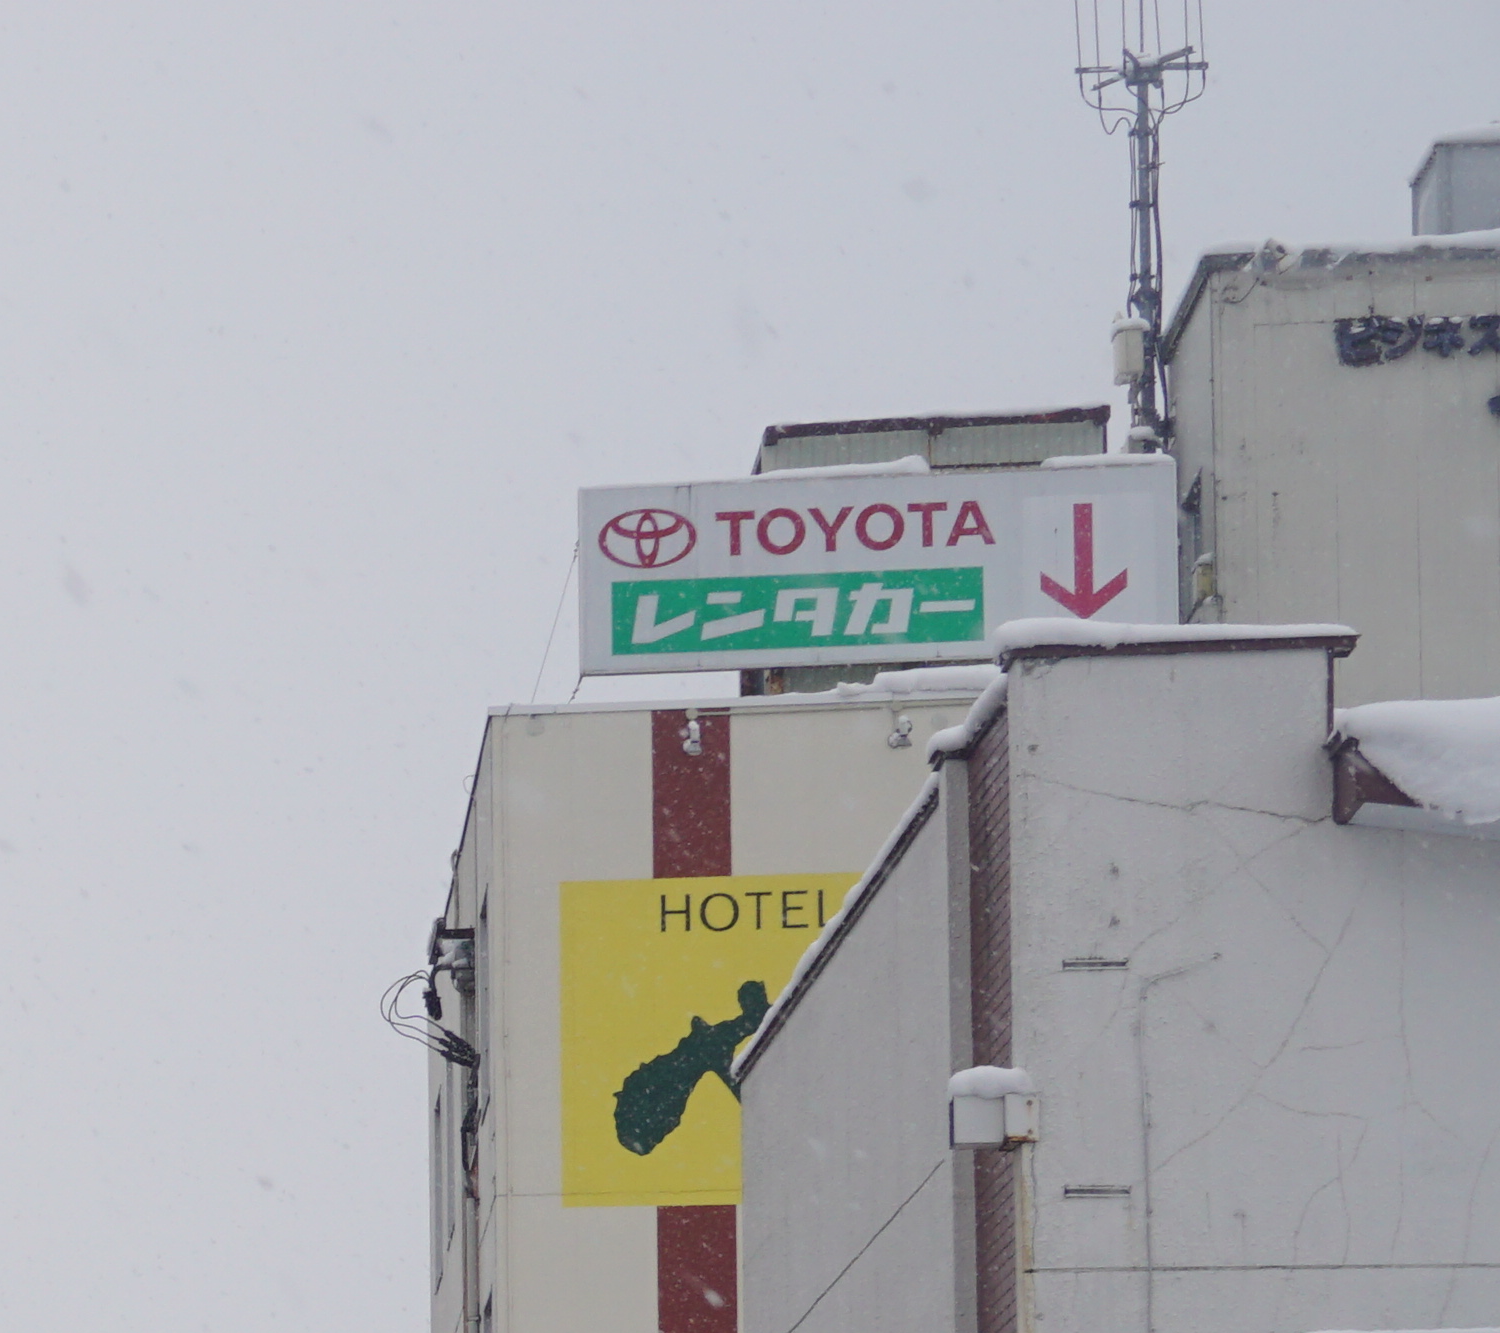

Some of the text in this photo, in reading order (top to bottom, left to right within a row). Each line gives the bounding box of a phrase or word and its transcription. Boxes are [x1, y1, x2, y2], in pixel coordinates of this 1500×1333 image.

[714, 501, 996, 557] TOYOTA
[631, 583, 976, 645] レンタカー
[659, 889, 832, 934] HOTEL
